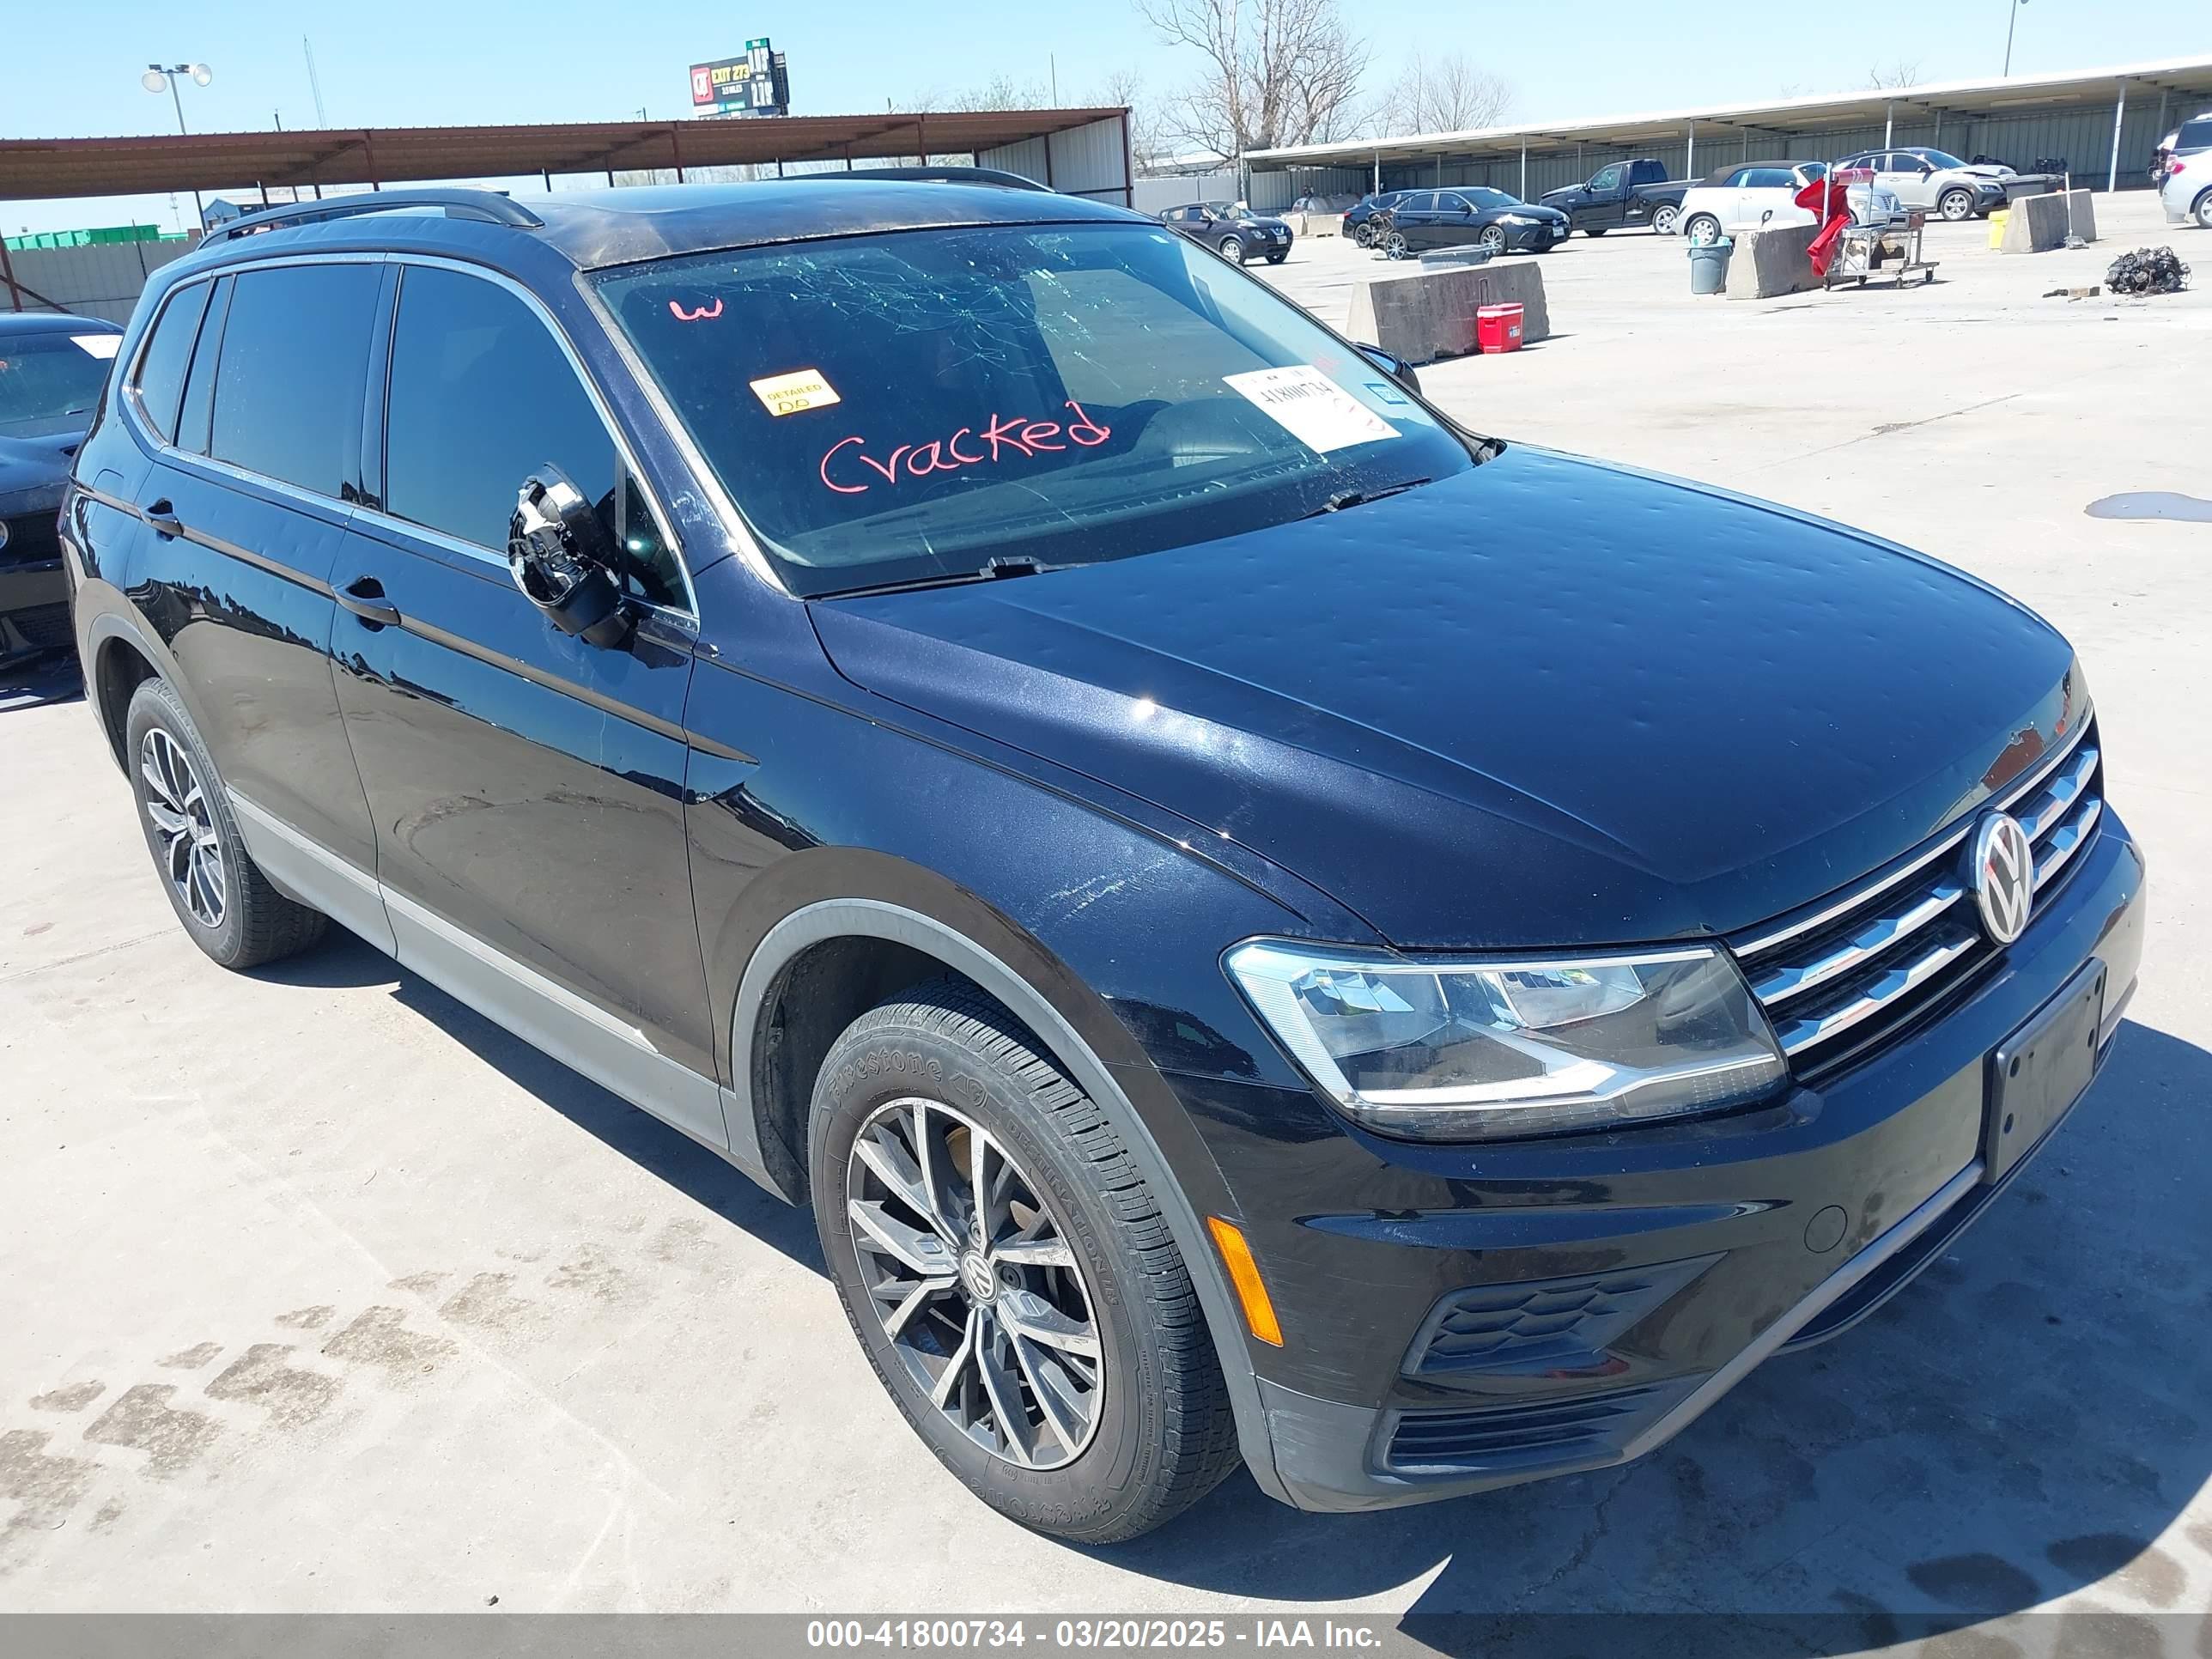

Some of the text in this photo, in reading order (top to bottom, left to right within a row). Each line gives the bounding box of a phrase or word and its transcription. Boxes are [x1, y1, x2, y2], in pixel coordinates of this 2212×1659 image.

[711, 64, 750, 84] EXIT 273
[767, 384, 822, 400] DETAILED
[1260, 381, 1335, 404] 41800734
[821, 400, 1111, 494] Cracked
[829, 1047, 943, 1108] Firestone
[1006, 1118, 1107, 1274] DESTINATION
